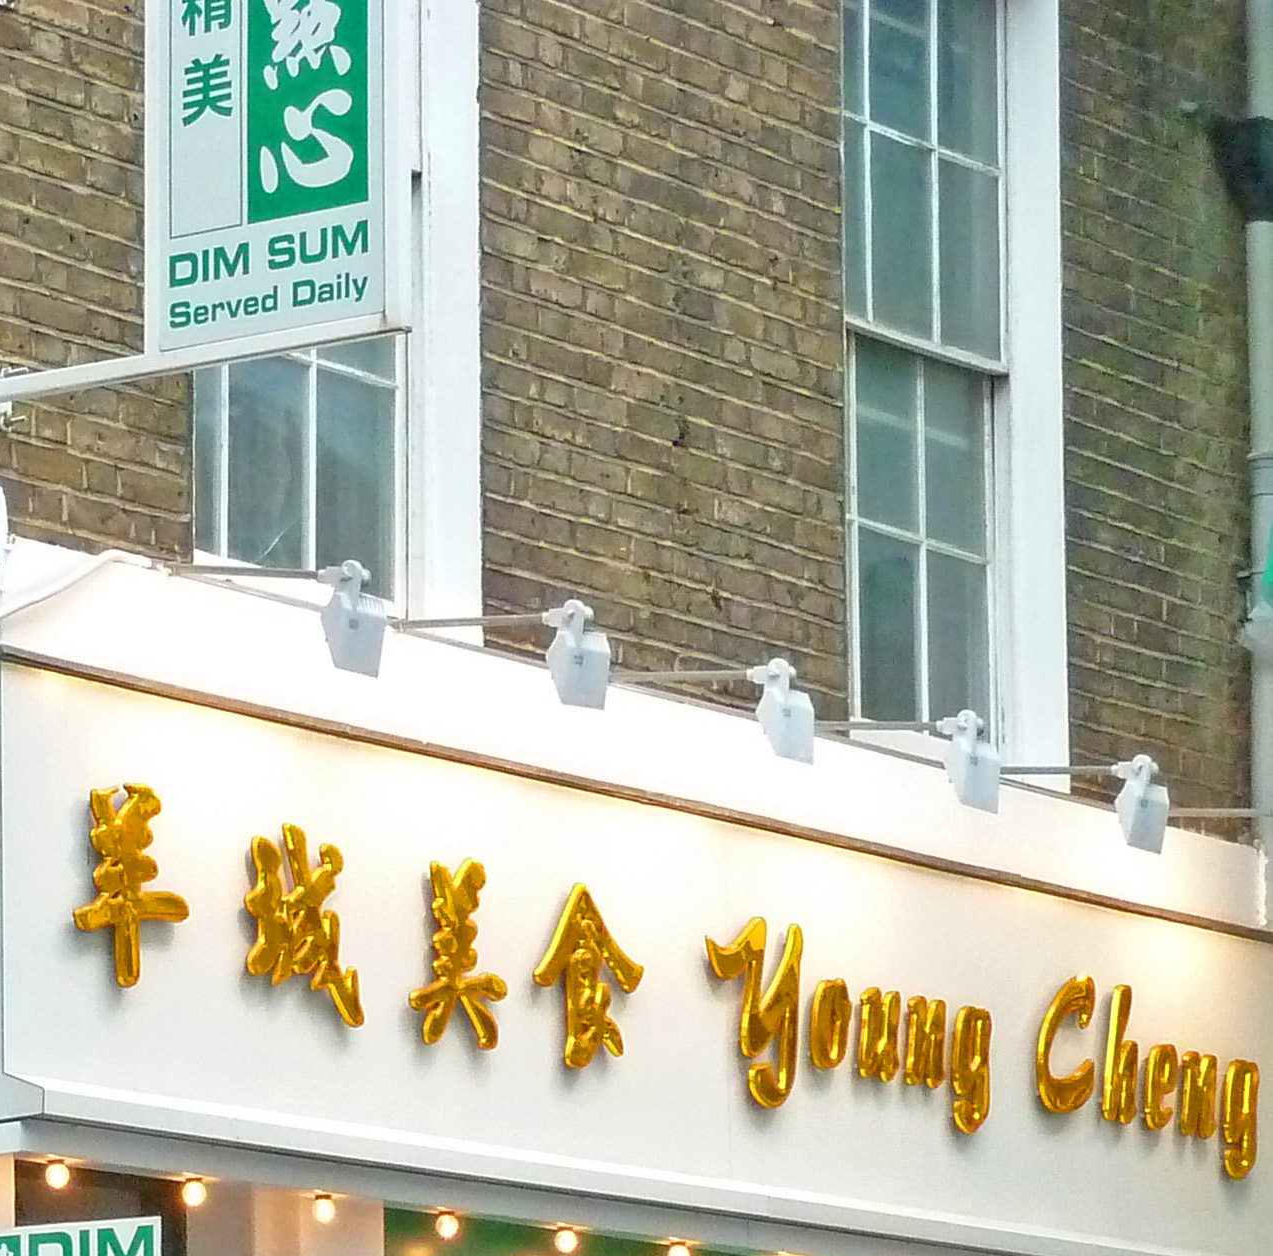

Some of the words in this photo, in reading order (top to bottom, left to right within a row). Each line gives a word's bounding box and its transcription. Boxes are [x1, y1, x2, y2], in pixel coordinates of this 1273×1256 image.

[169, 242, 249, 288] DIM
[268, 220, 368, 270] SUM
[169, 286, 278, 328] Served
[292, 272, 368, 307] Daily
[706, 917, 991, 1133] Young
[1036, 975, 1259, 1181] Cheng
